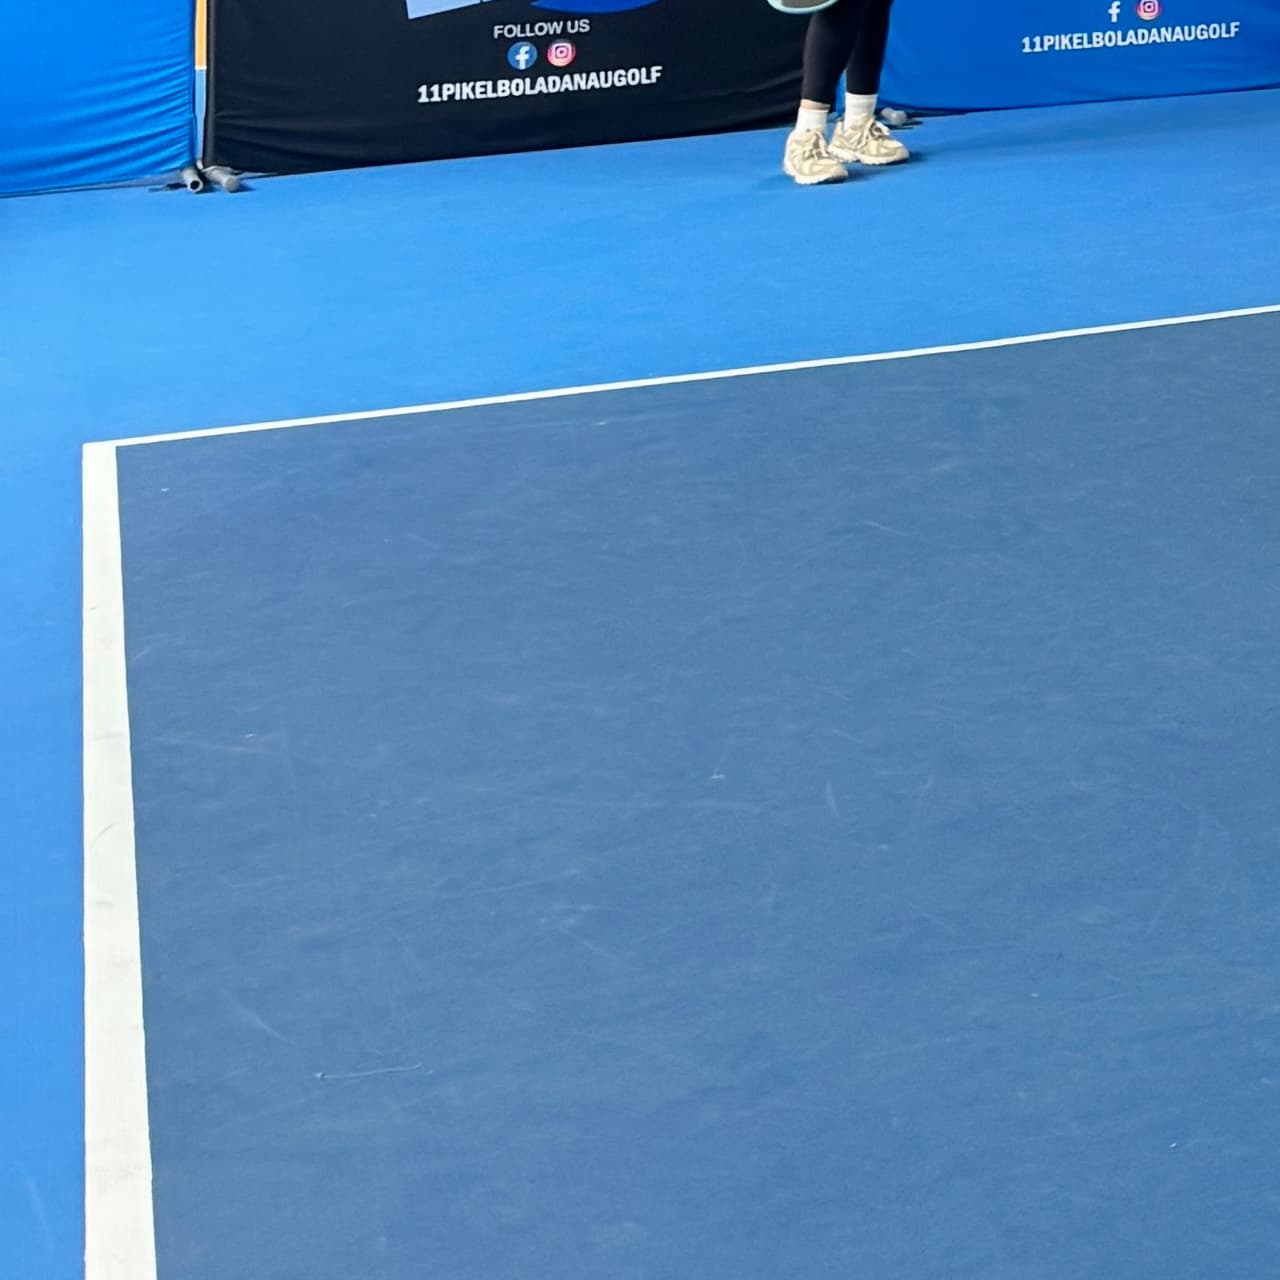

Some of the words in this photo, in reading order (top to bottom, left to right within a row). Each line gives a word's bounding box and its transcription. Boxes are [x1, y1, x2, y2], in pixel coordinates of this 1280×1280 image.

[493, 20, 564, 39] FOLLOW
[566, 19, 590, 33] US
[1021, 21, 1241, 53] 11PIKELBOLADANAUGOLF
[417, 66, 663, 103] 11PIKELBOLADANAUGOLF
